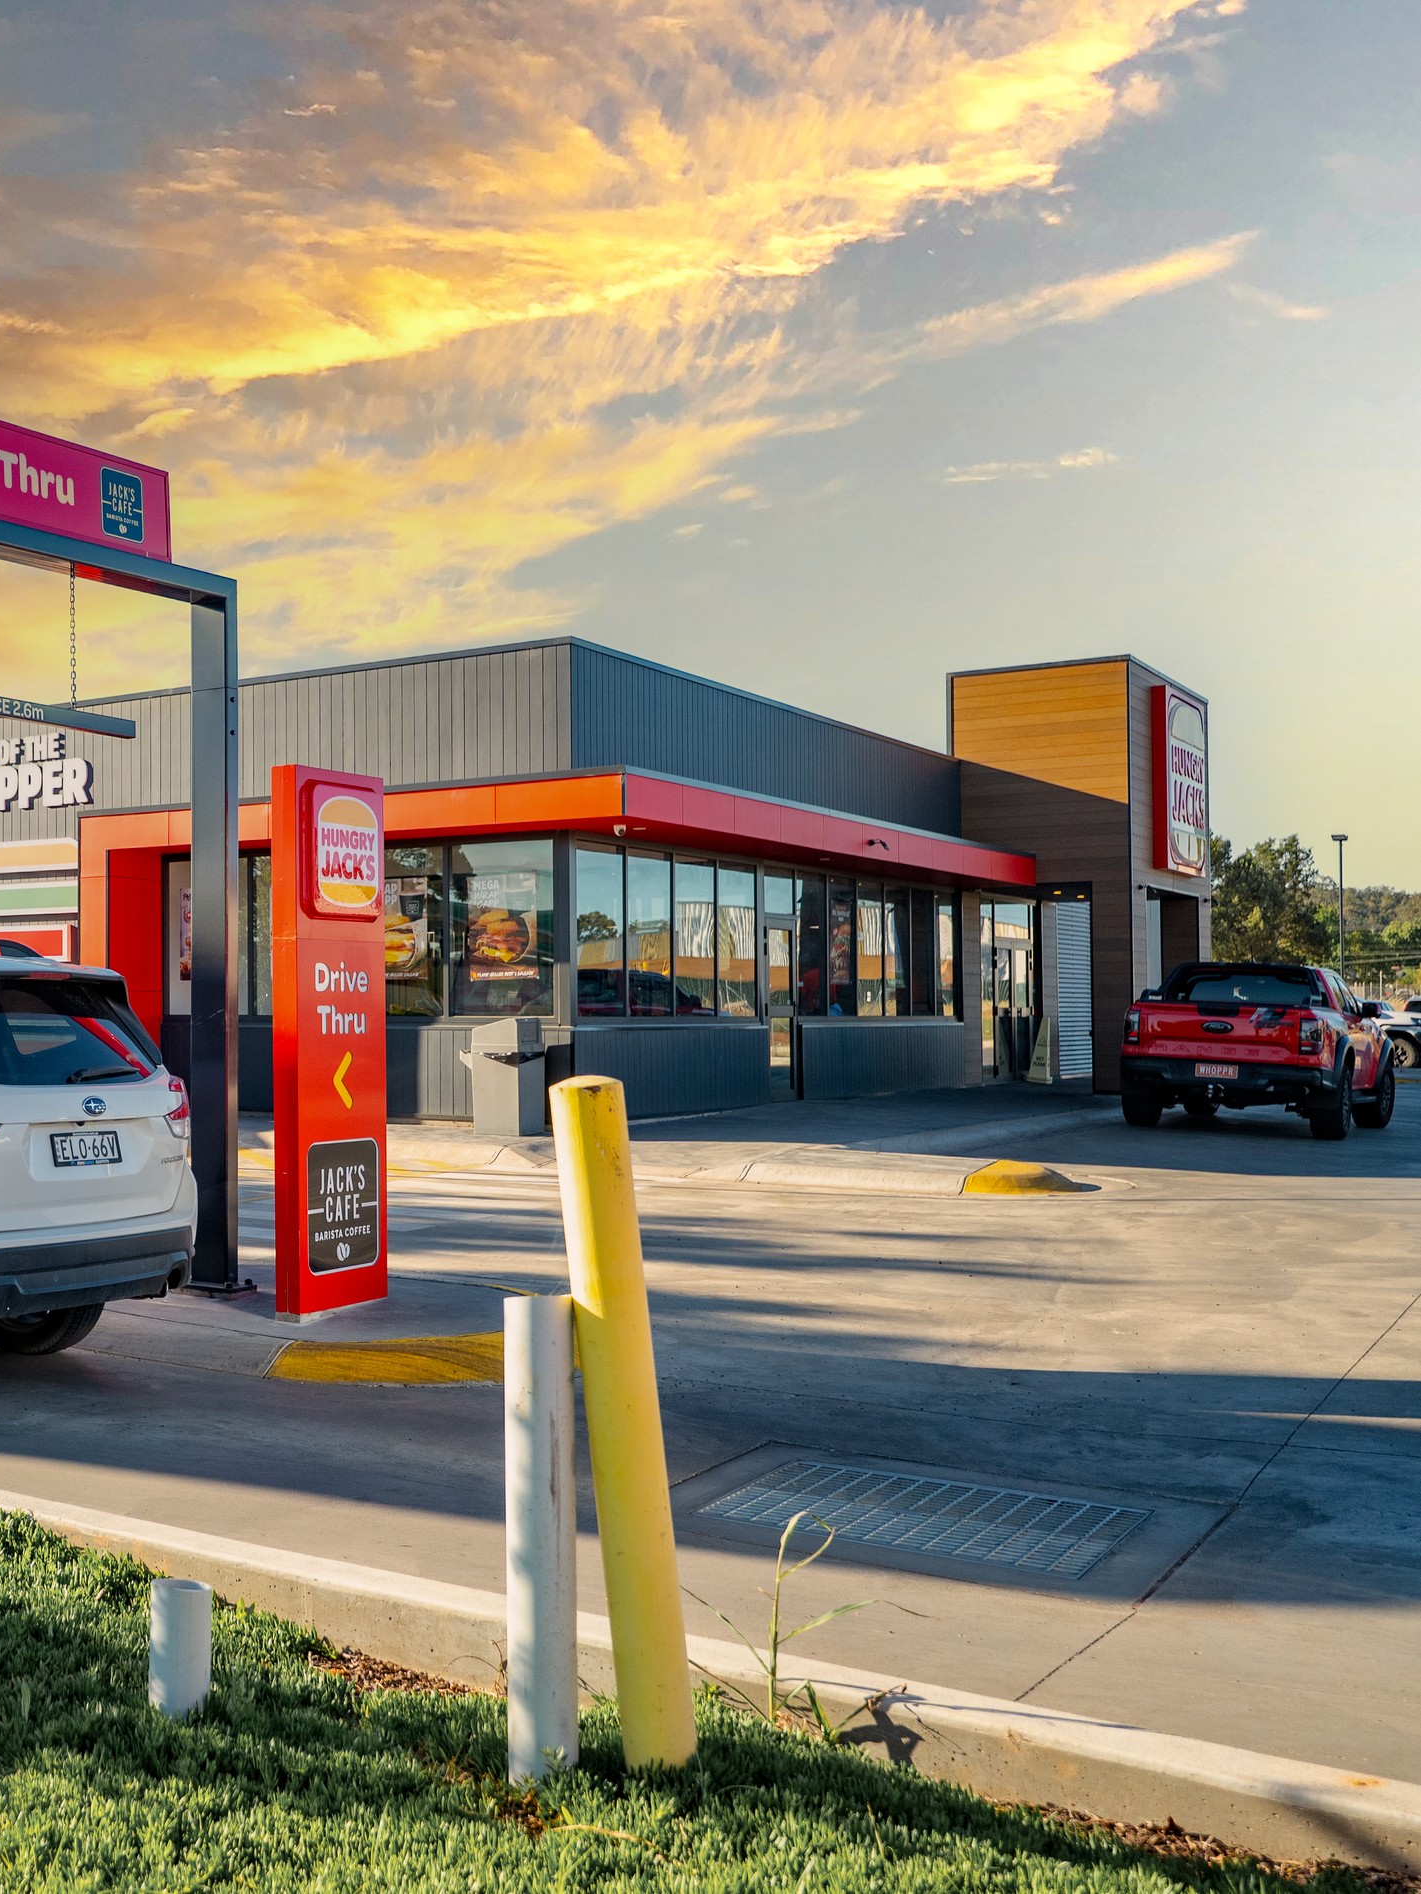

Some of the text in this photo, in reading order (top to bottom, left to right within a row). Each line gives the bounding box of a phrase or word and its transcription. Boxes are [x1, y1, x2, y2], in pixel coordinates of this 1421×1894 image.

[108, 481, 135, 502] JACK'S
[112, 497, 133, 516] CAFE
[12, 701, 44, 721] 2.6m
[23, 732, 62, 762] THE
[1171, 744, 1204, 785] HUNGRY
[321, 827, 375, 852] HUNGRY
[321, 850, 376, 882] JACK'S
[473, 879, 499, 891] MEGA
[314, 961, 368, 993] Drive
[316, 1005, 367, 1035] Thru
[1199, 1065, 1234, 1076] WHOPPR
[319, 1164, 366, 1195] JACK'S
[325, 1193, 360, 1223] CAFE
[314, 1224, 371, 1242] BARISTA COFFEE
